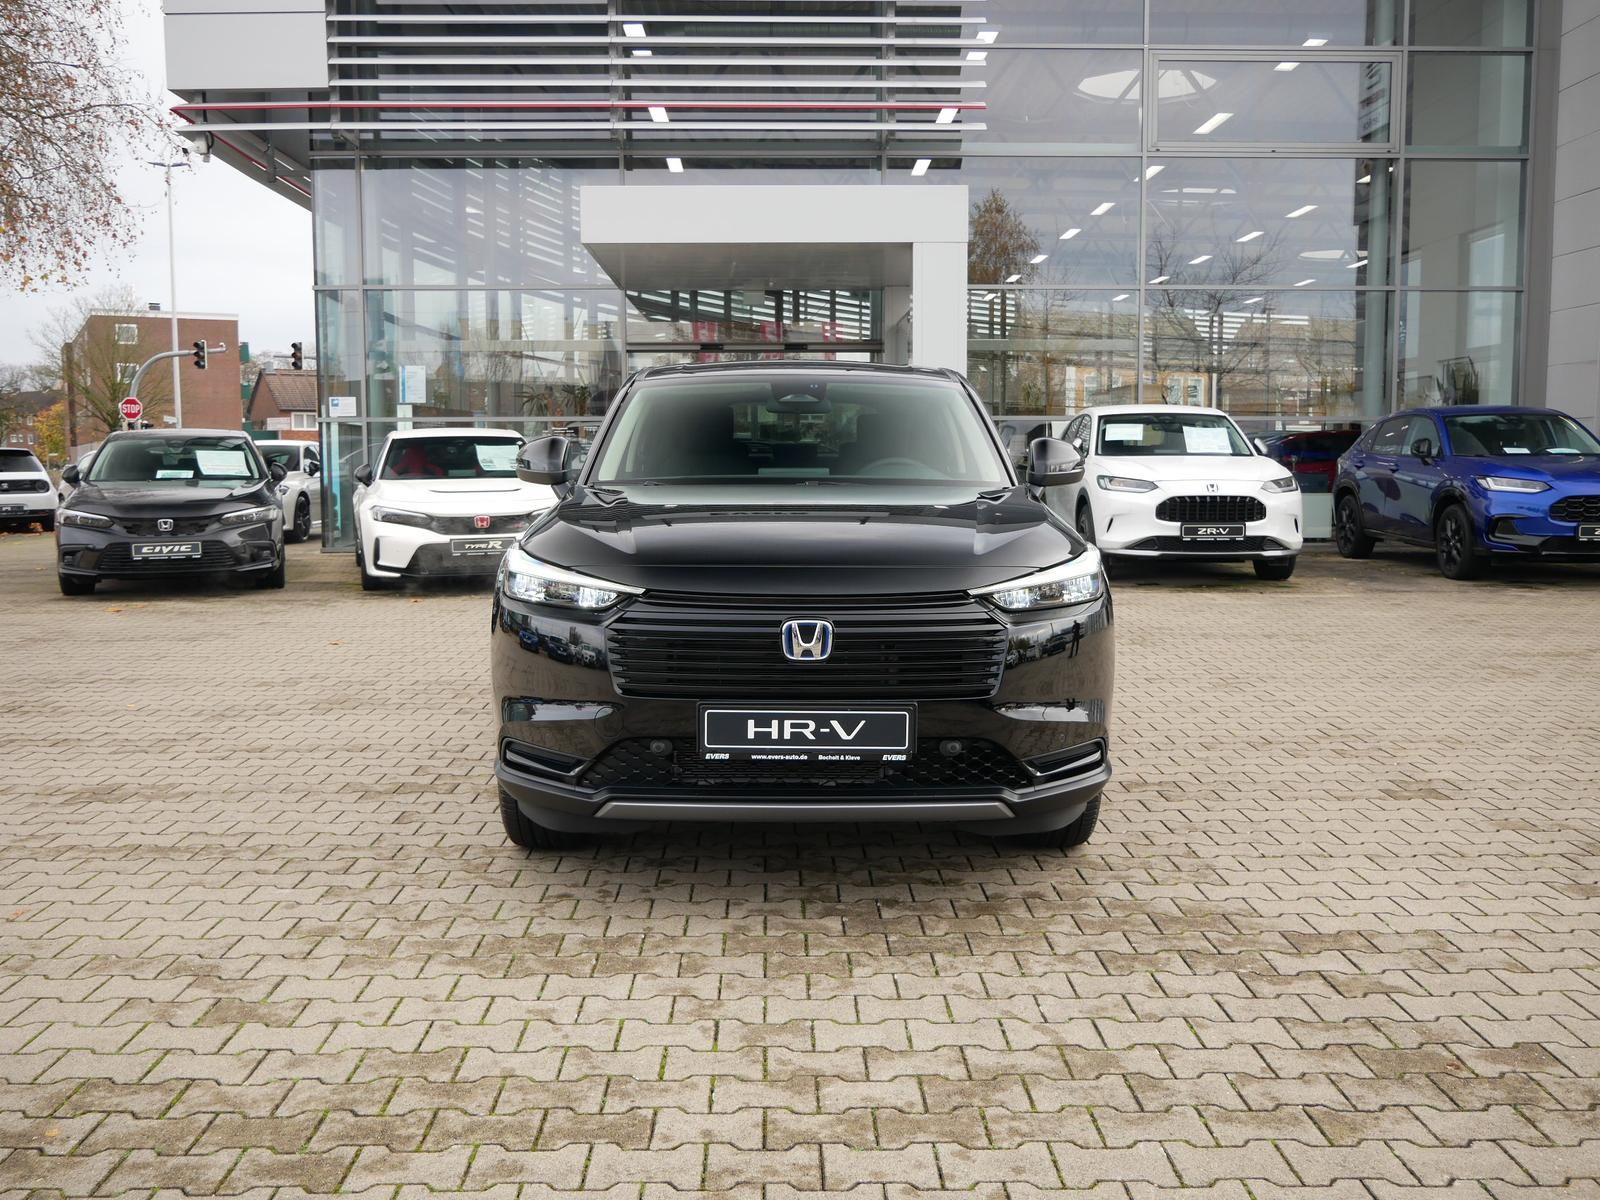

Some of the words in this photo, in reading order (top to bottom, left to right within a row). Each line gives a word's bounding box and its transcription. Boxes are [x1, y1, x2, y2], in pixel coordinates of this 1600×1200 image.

[122, 404, 140, 414] STOP
[141, 544, 193, 554] CIVIC
[747, 719, 866, 740] HR-V
